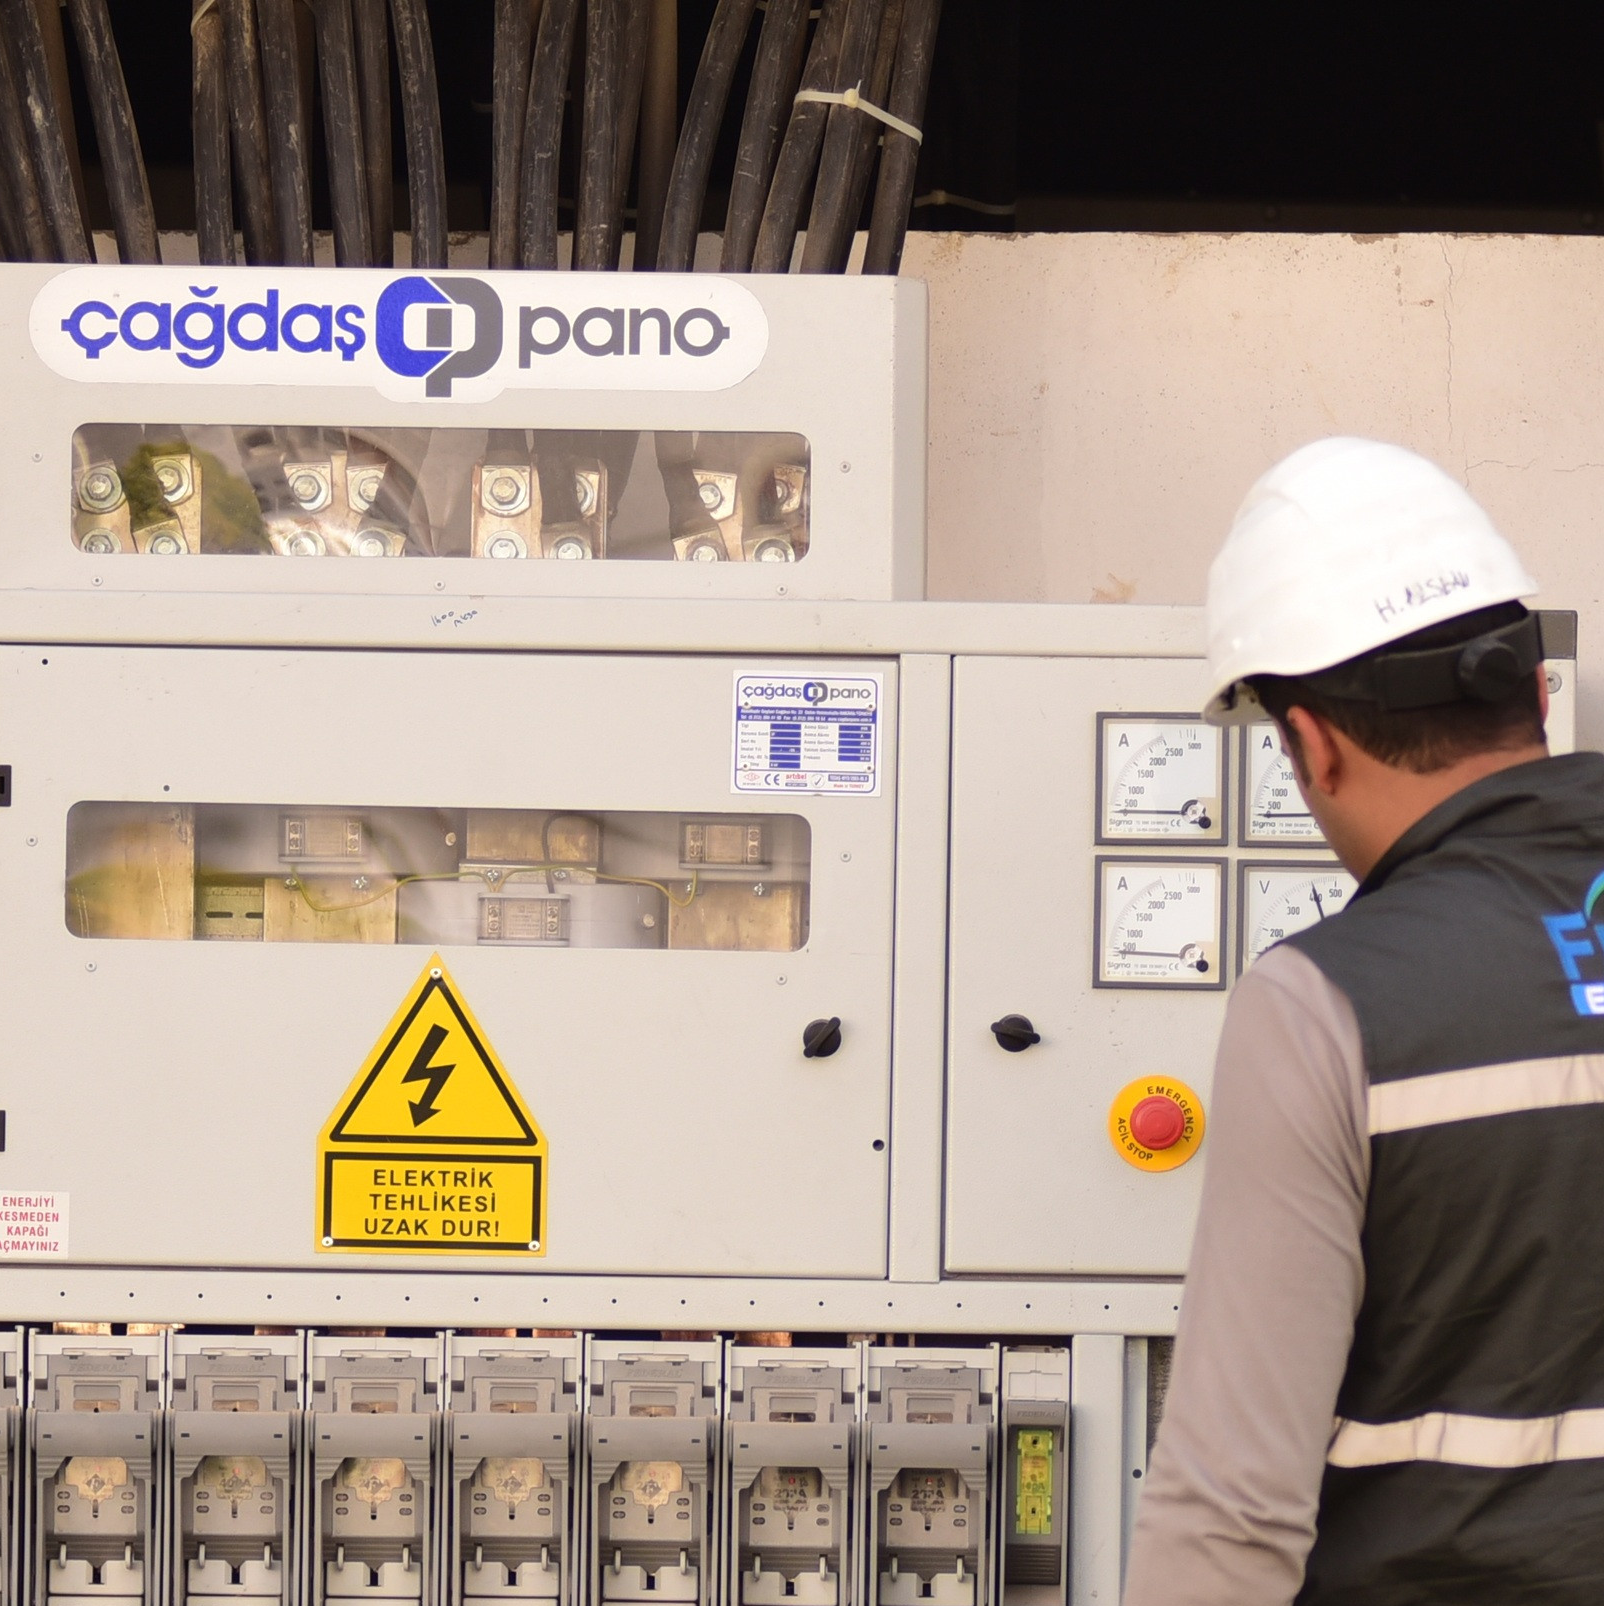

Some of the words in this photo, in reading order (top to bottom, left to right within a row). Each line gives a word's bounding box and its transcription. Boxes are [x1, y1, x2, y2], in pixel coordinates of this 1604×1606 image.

[61, 285, 366, 369] çağdaş
[519, 306, 730, 368] pano
[742, 682, 802, 700] çağdaş
[830, 687, 871, 701] pano
[1118, 733, 1129, 747] A
[1262, 735, 1273, 749] A
[1165, 748, 1184, 757] 2500
[1149, 757, 1167, 766] 2000
[1137, 770, 1154, 778] 1500
[1128, 786, 1145, 795] 1000
[1272, 788, 1288, 797] 1000
[1124, 799, 1138, 807] 500
[1268, 801, 1281, 810] 500
[1117, 876, 1128, 890] A
[1259, 880, 1270, 894] V
[1164, 891, 1183, 900] 2500
[1328, 889, 1343, 898] 500
[1148, 900, 1166, 909] 2000
[1287, 906, 1300, 915] 300
[1136, 913, 1153, 921] 1500
[1127, 929, 1143, 938] 1000
[1270, 928, 1284, 938] 200
[1123, 942, 1136, 951] 500
[1147, 1086, 1194, 1143] EMERGENCY
[1126, 1142, 1153, 1161] STOP
[373, 1167, 494, 1188] ELEKTRİK
[1, 1195, 55, 1208] ENERJİYİ
[369, 1191, 497, 1213] TEHLİKESİ
[6, 1223, 49, 1237] KAPAĞI
[364, 1218, 429, 1236] UZAK
[442, 1219, 500, 1237] DUR!
